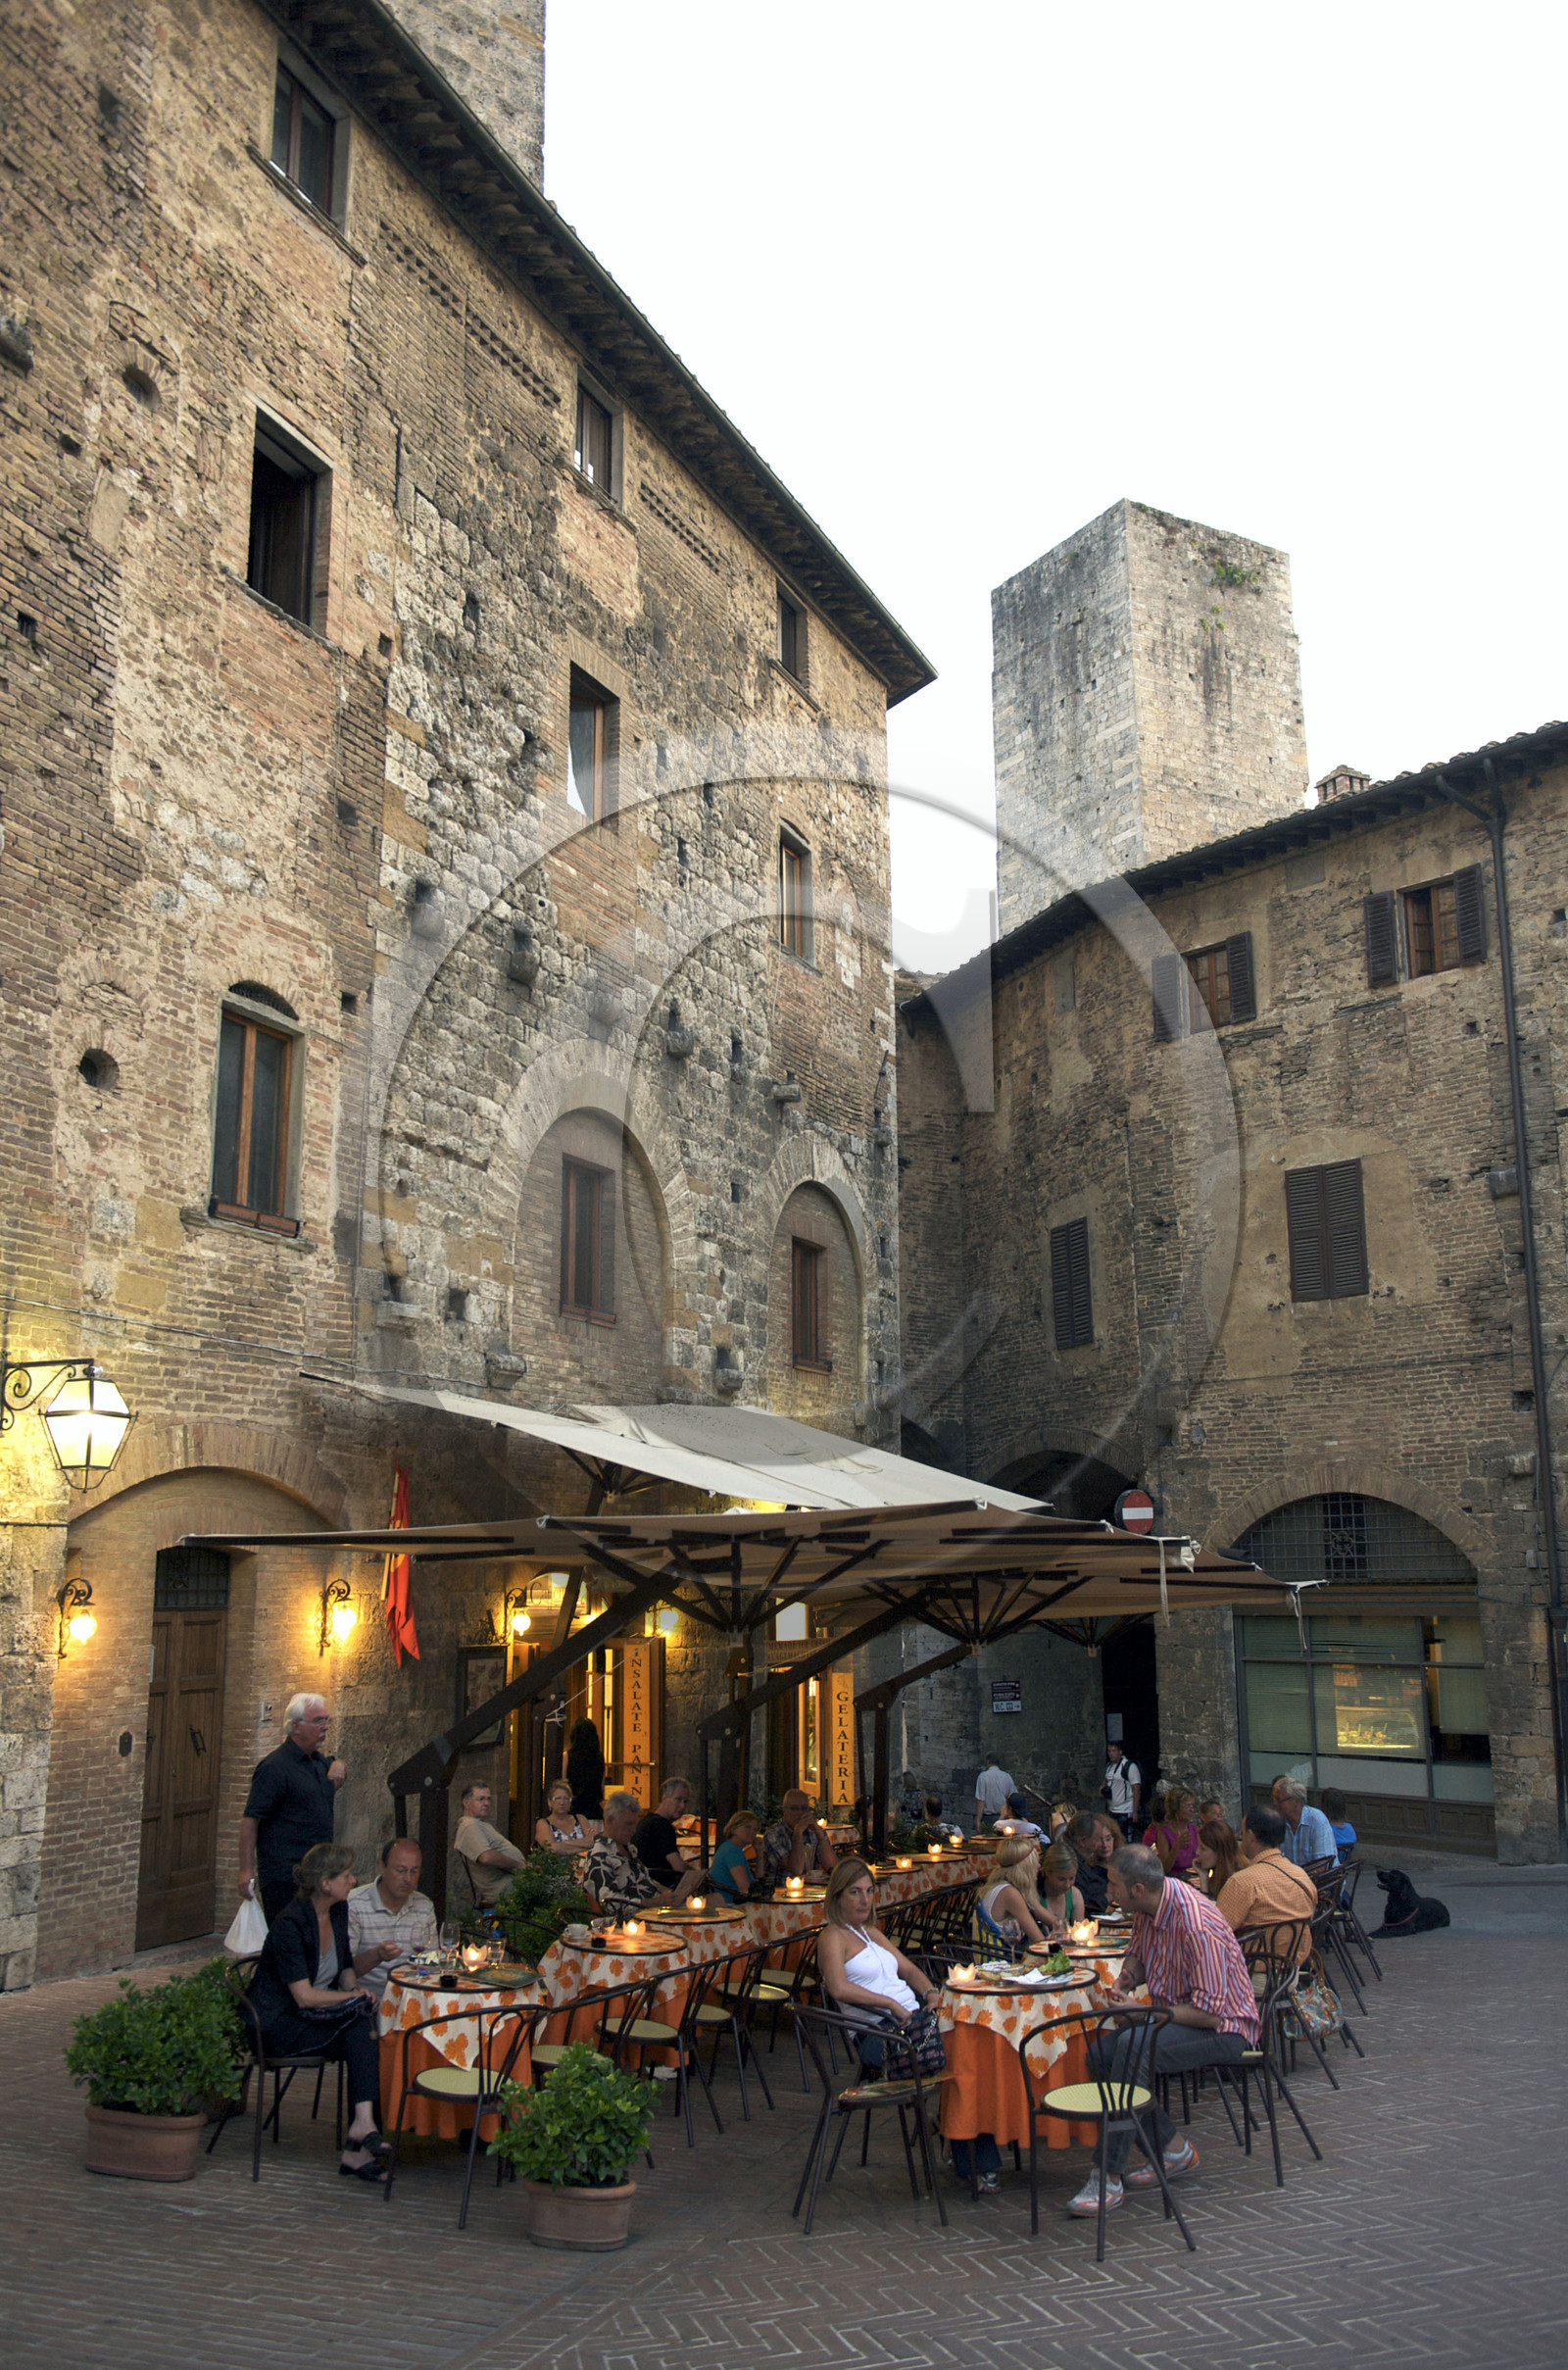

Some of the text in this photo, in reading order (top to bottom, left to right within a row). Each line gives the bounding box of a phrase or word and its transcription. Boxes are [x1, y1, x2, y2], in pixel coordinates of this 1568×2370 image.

[630, 1649, 643, 1800] INSALATE PANIN
[836, 1692, 850, 1803] GELATERIA
